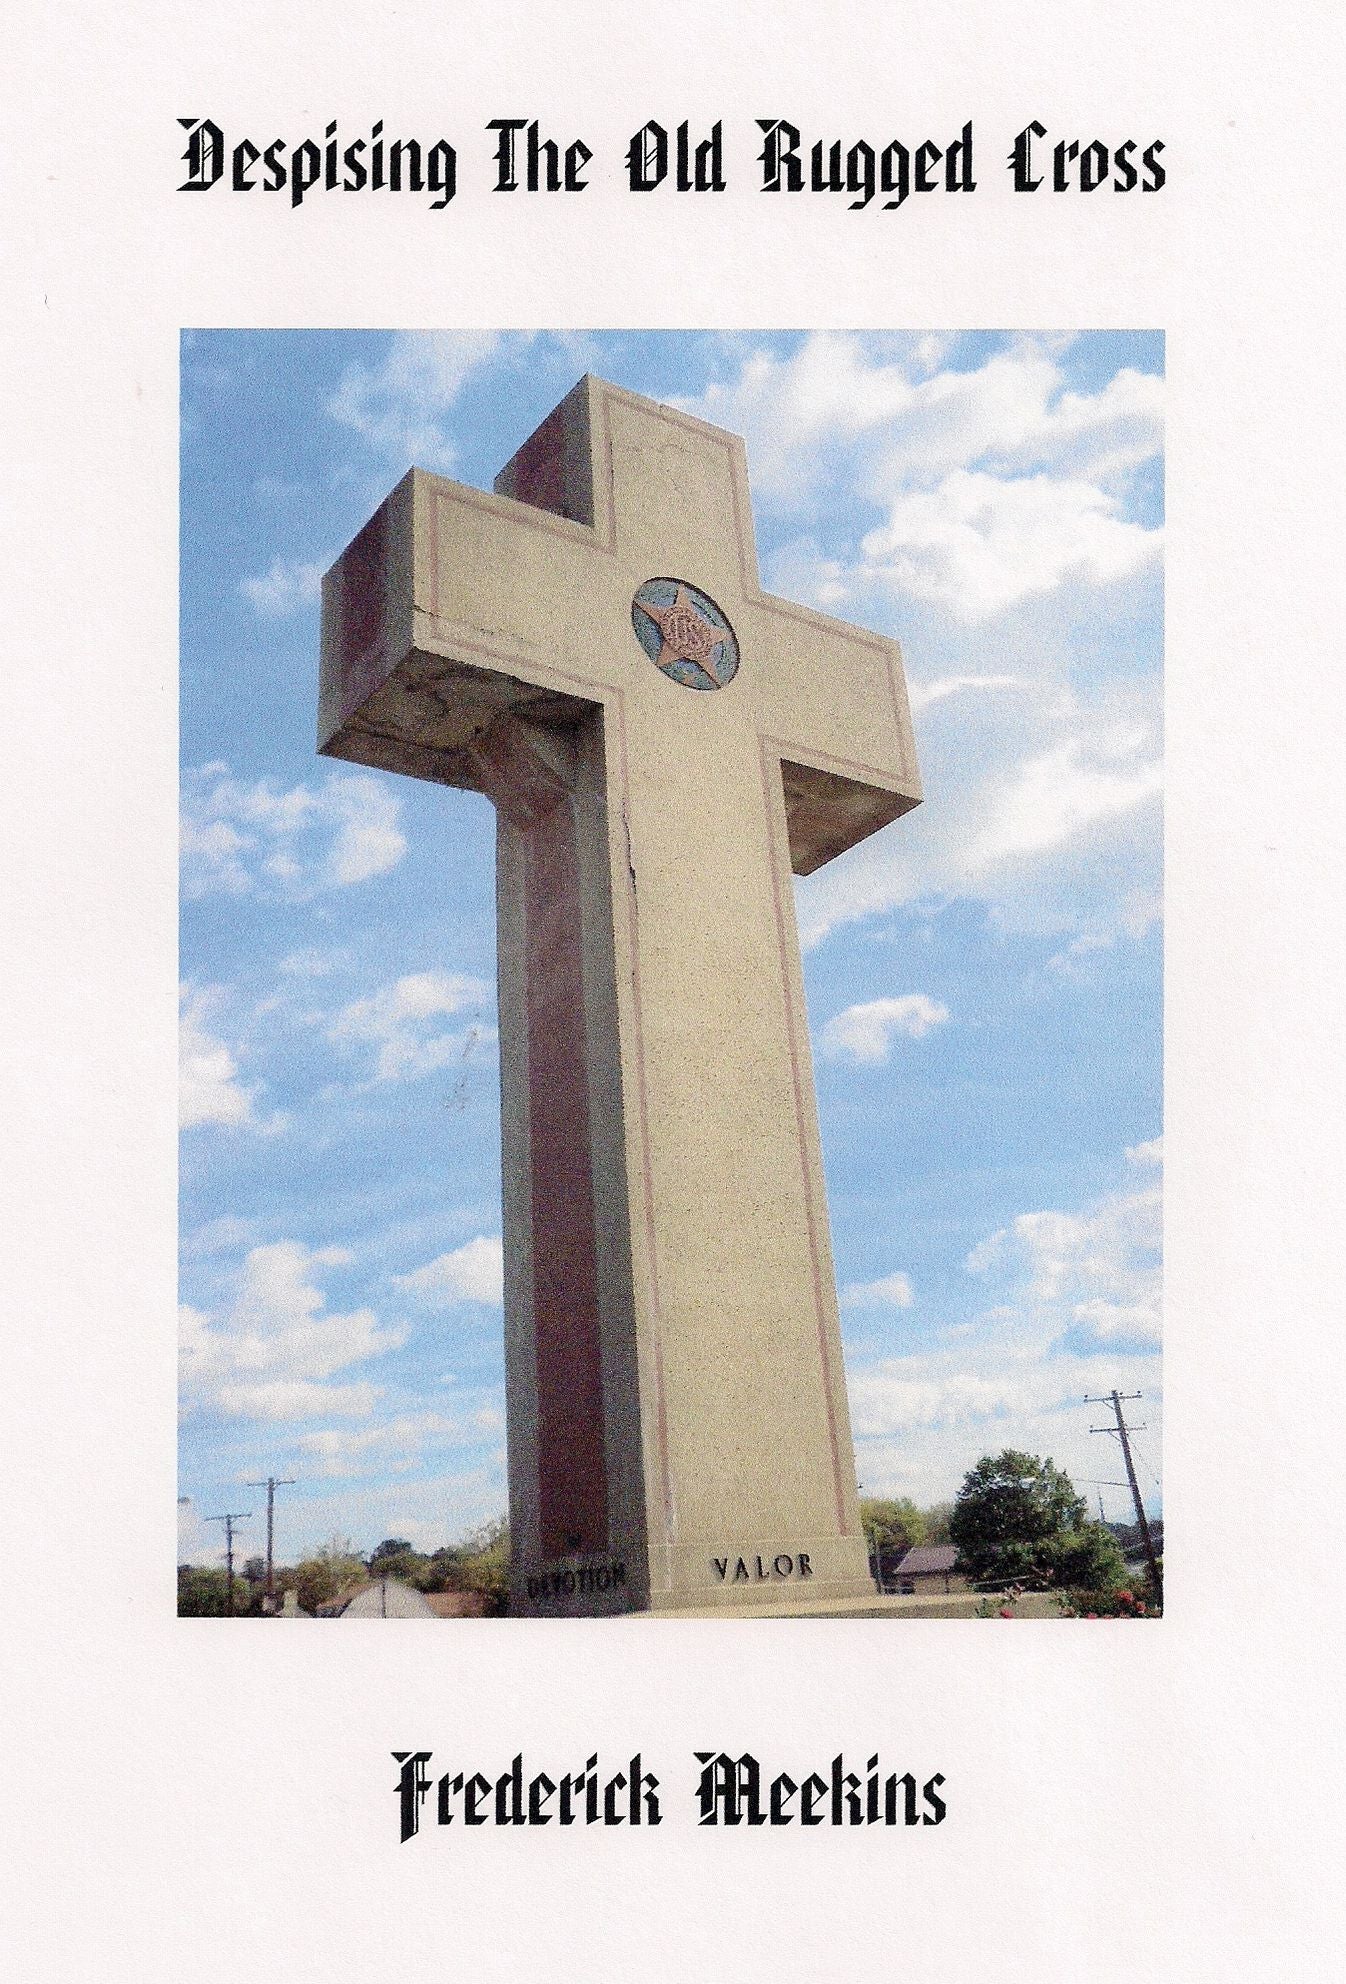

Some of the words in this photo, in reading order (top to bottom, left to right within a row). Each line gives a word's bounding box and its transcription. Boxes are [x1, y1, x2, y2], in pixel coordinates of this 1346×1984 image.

[175, 118, 457, 210] Despising
[484, 118, 594, 193] The
[624, 119, 727, 193] Old
[754, 119, 978, 211] Rugged
[1006, 119, 1166, 193] Cross
[712, 1553, 813, 1581] VALOR
[390, 1751, 664, 1844] Frederick
[692, 1751, 947, 1826] Meekins
